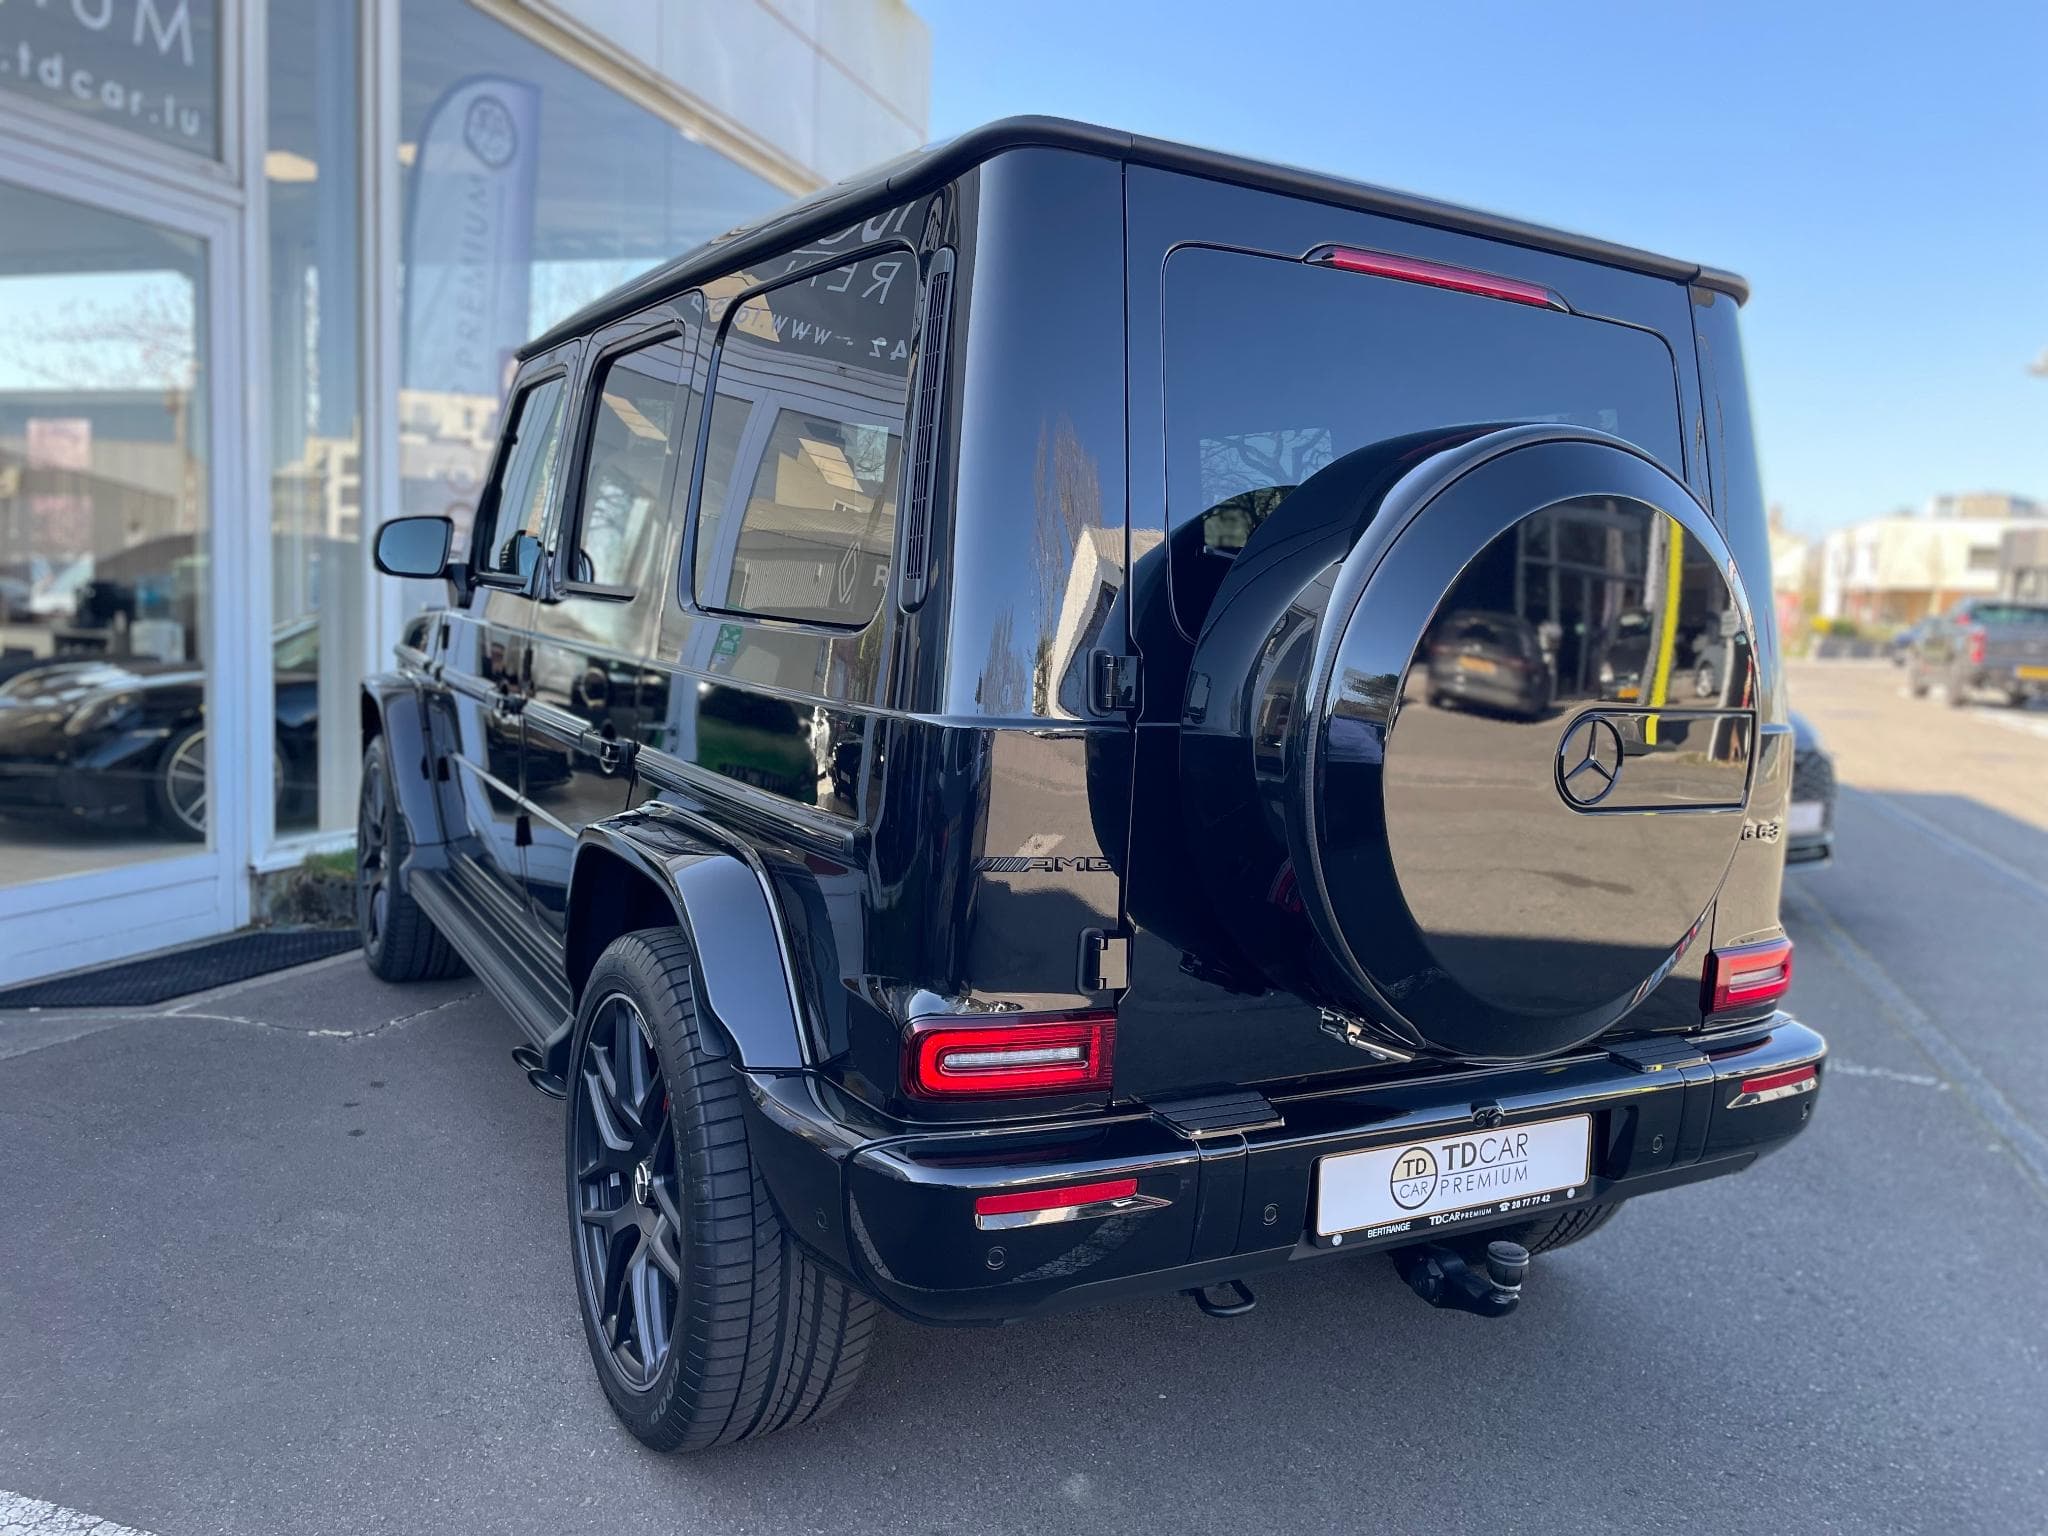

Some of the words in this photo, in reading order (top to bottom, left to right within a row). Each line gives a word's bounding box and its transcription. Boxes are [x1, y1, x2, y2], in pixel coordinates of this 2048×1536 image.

[1441, 1132, 1529, 1171] TDCAR
[1402, 1157, 1427, 1178] TD
[1399, 1181, 1429, 1199] CAR
[1440, 1165, 1528, 1196] PREMIUM
[1367, 1221, 1411, 1239] BERTRANGE
